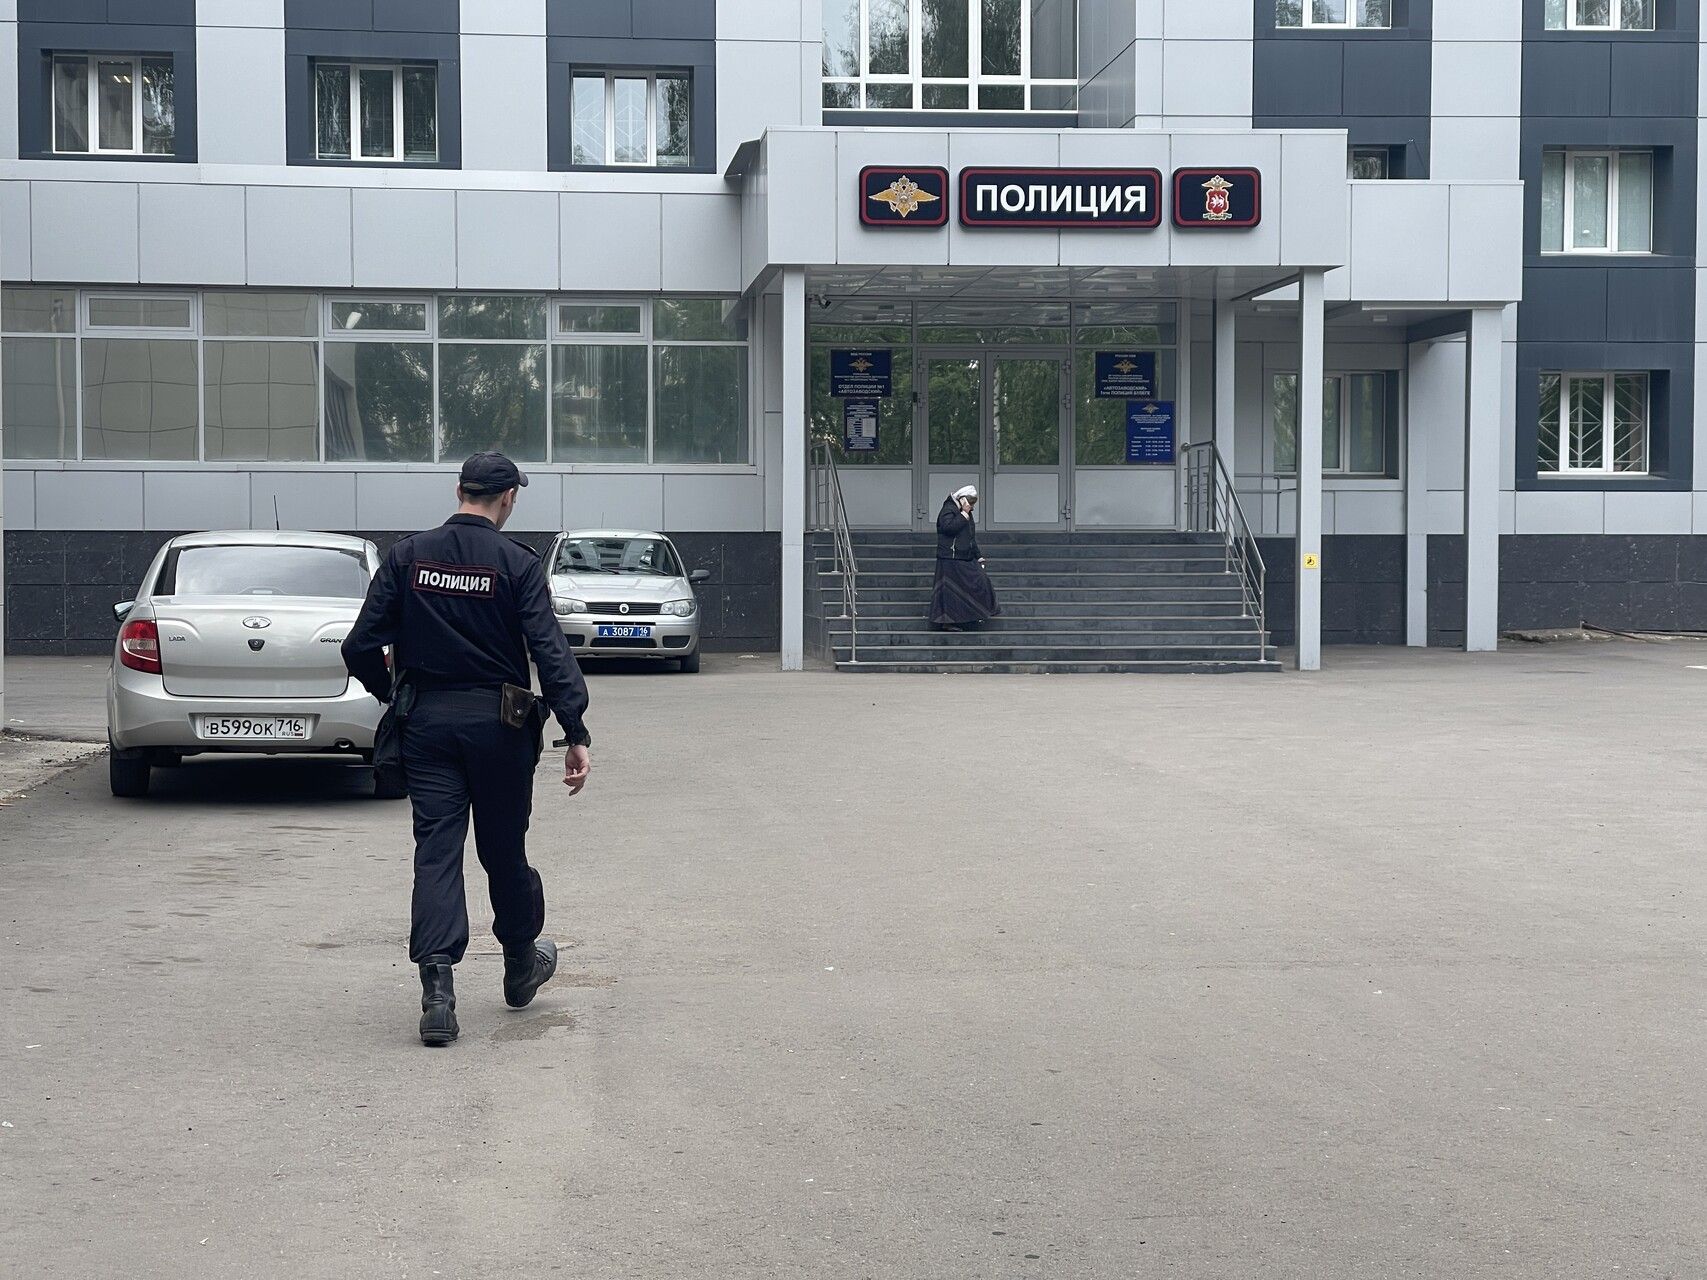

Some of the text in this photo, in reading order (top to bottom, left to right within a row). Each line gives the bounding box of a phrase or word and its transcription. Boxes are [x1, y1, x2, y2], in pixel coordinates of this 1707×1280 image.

[976, 184, 1147, 218] ПОЛИЦИЯ
[418, 569, 491, 592] ПОЛИЦИЯ
[612, 627, 635, 636] 3087
[277, 719, 301, 732] 716
